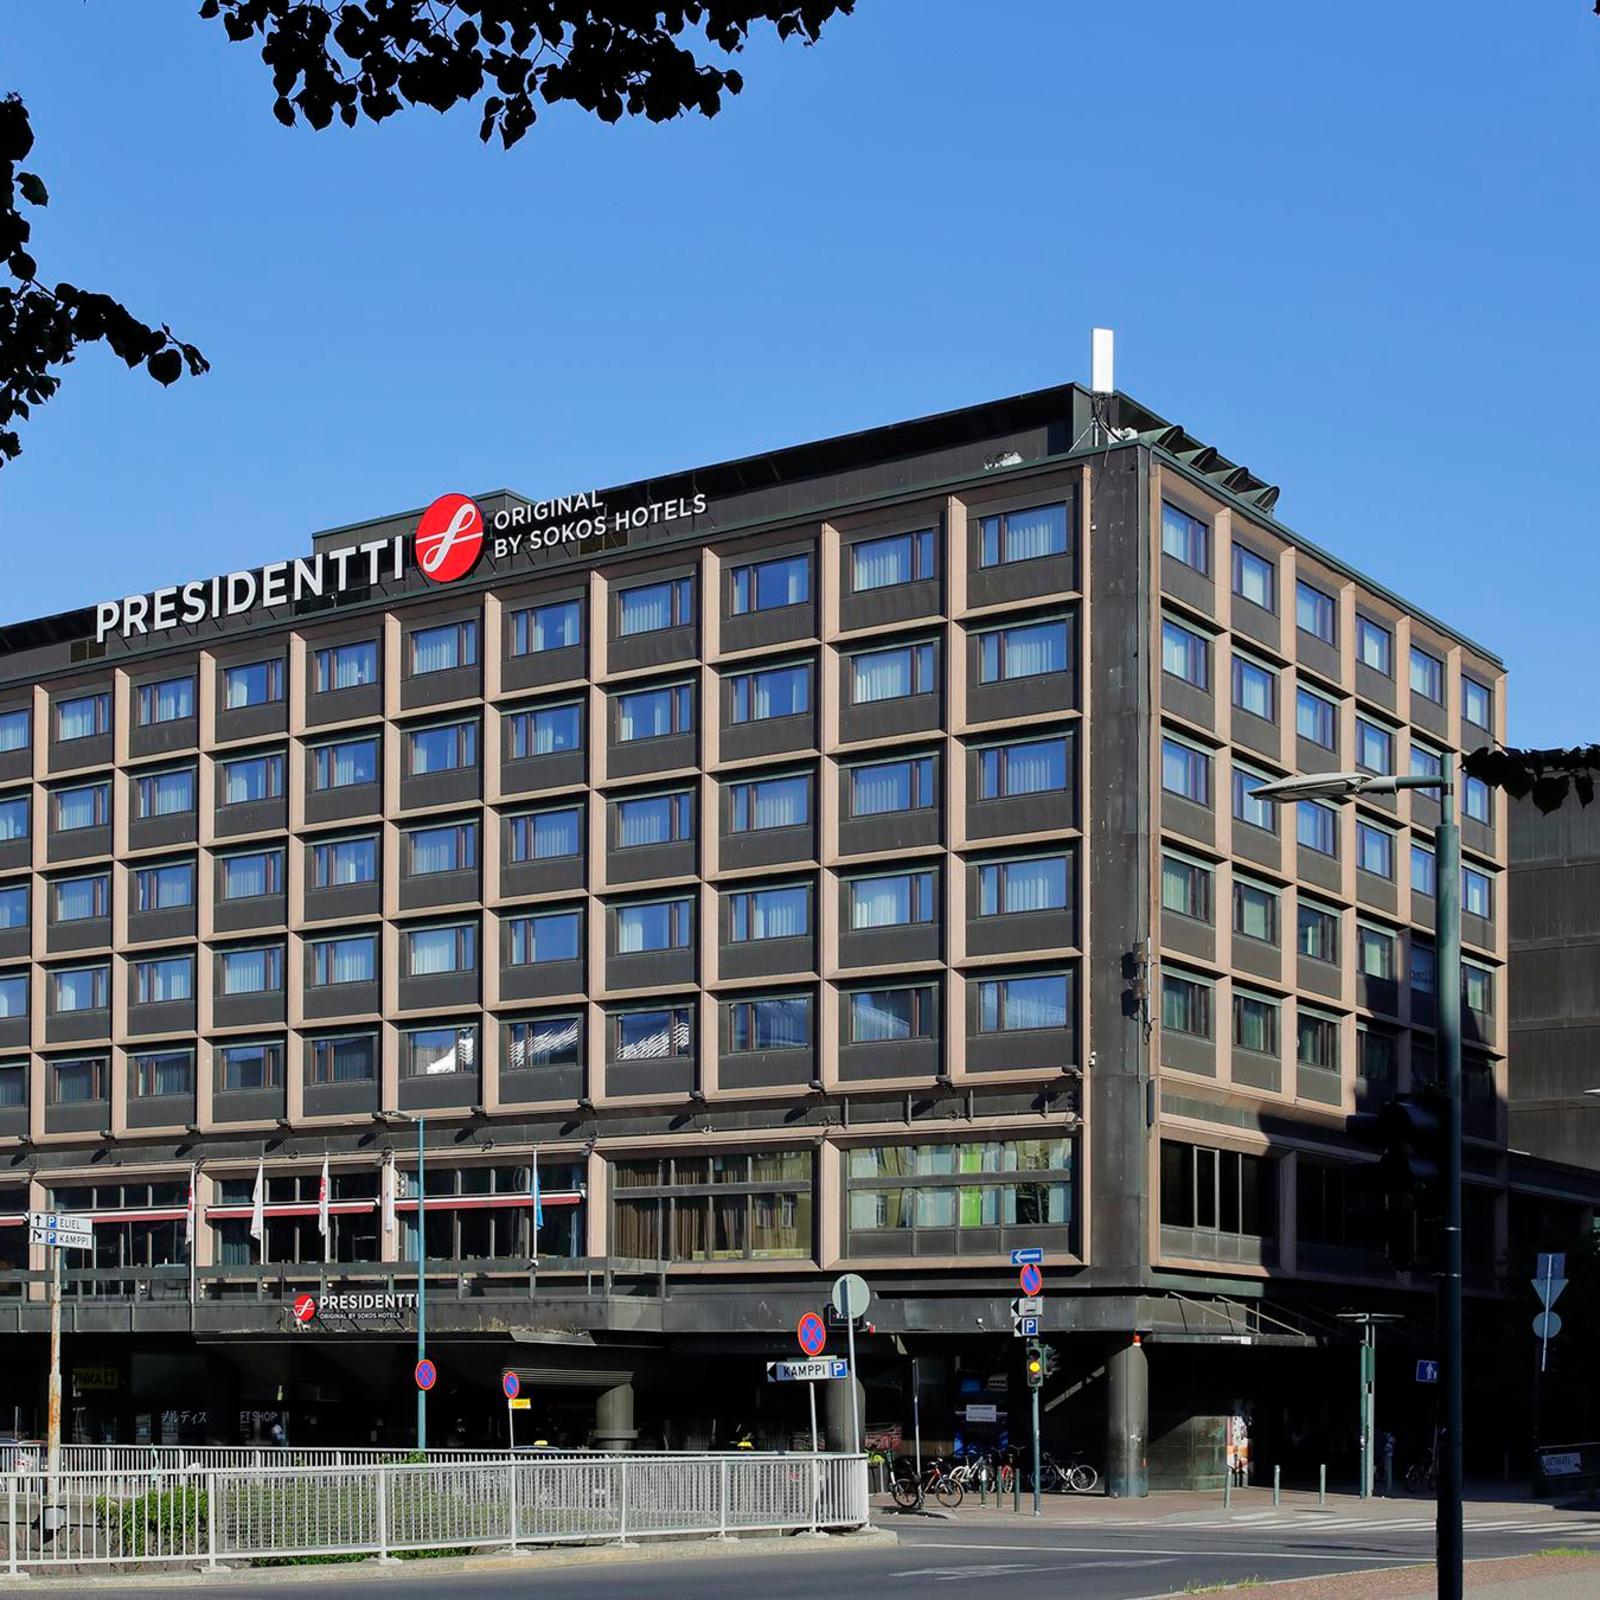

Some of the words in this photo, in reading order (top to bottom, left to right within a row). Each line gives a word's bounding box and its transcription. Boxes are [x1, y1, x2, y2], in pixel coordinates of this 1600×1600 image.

[493, 489, 604, 531] ORIGINAL
[494, 538, 523, 558] BY
[529, 515, 607, 550] SOKOS
[615, 493, 707, 531] HOTELS
[96, 535, 403, 643] PRESIDENTTI
[60, 1217, 80, 1230] ELIEL
[60, 1233, 89, 1246] KAMPPI
[319, 1293, 419, 1310] PRESIDENTTI
[319, 1312, 347, 1320] ORIGINAL
[348, 1312, 356, 1320] BY
[357, 1312, 377, 1320] SOKOS
[378, 1311, 401, 1319] HOTELS
[1026, 1319, 1035, 1333] P
[783, 1363, 826, 1378] KAMPPI
[833, 1362, 843, 1376] P
[251, 1409, 278, 1423] SHOP
